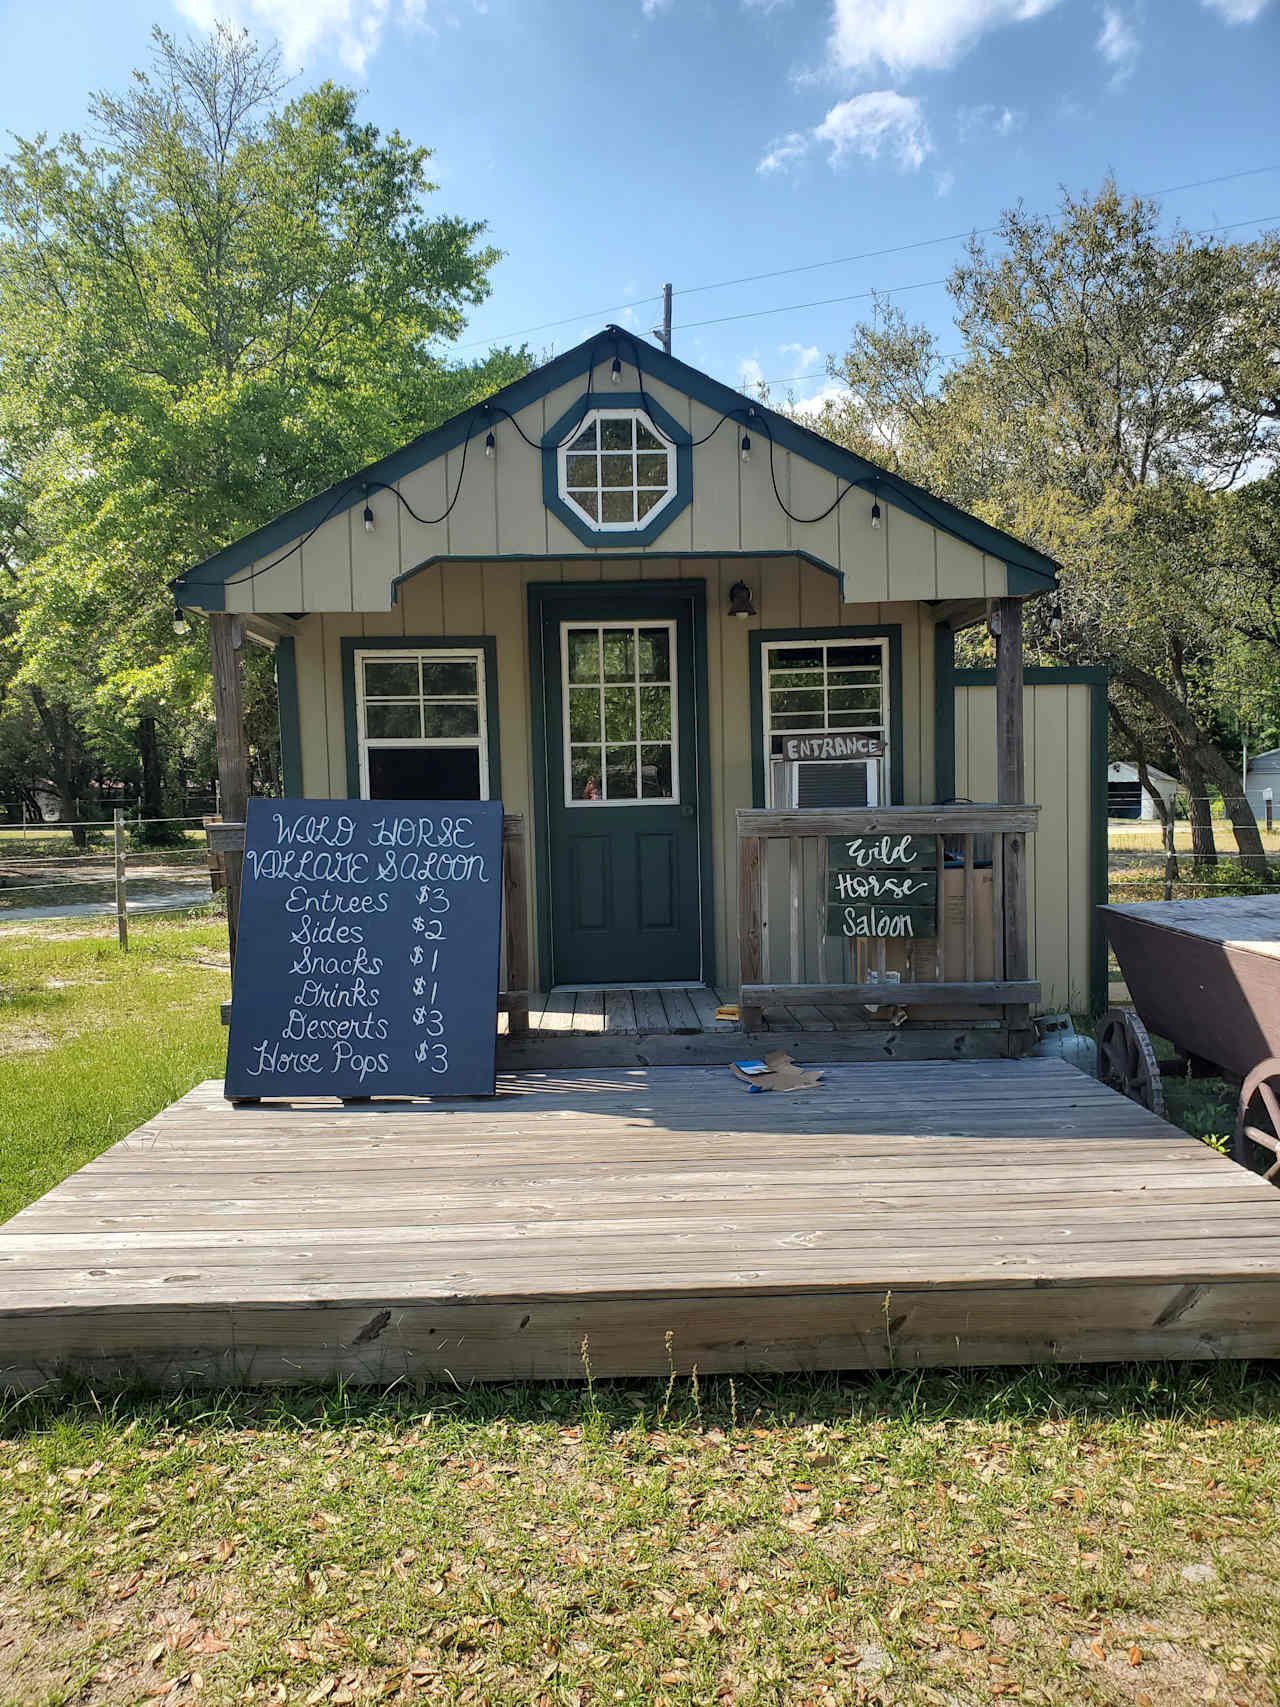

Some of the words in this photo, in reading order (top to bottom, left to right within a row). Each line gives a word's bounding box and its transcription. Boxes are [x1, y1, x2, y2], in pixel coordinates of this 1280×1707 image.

[786, 737, 880, 759] ENTRANCE
[272, 813, 357, 848] WILD
[367, 816, 476, 849] HORSE
[245, 849, 369, 884] VILLAGE
[375, 850, 490, 883] SALOON
[846, 834, 918, 868] Wild
[284, 885, 389, 914] Entrees
[415, 884, 450, 914] $3
[835, 872, 928, 899] Horse
[288, 914, 364, 944] Sides
[411, 915, 447, 941] $2
[842, 906, 914, 938] Saloon
[288, 945, 384, 977] Snacks
[409, 944, 439, 973] $1
[293, 975, 380, 1008] Drinks
[412, 975, 438, 1005] $1
[281, 1009, 389, 1041] Desserts
[412, 1006, 444, 1037] $3
[245, 1038, 324, 1076] Horse
[328, 1036, 392, 1084] Pops
[414, 1039, 449, 1074] $3
